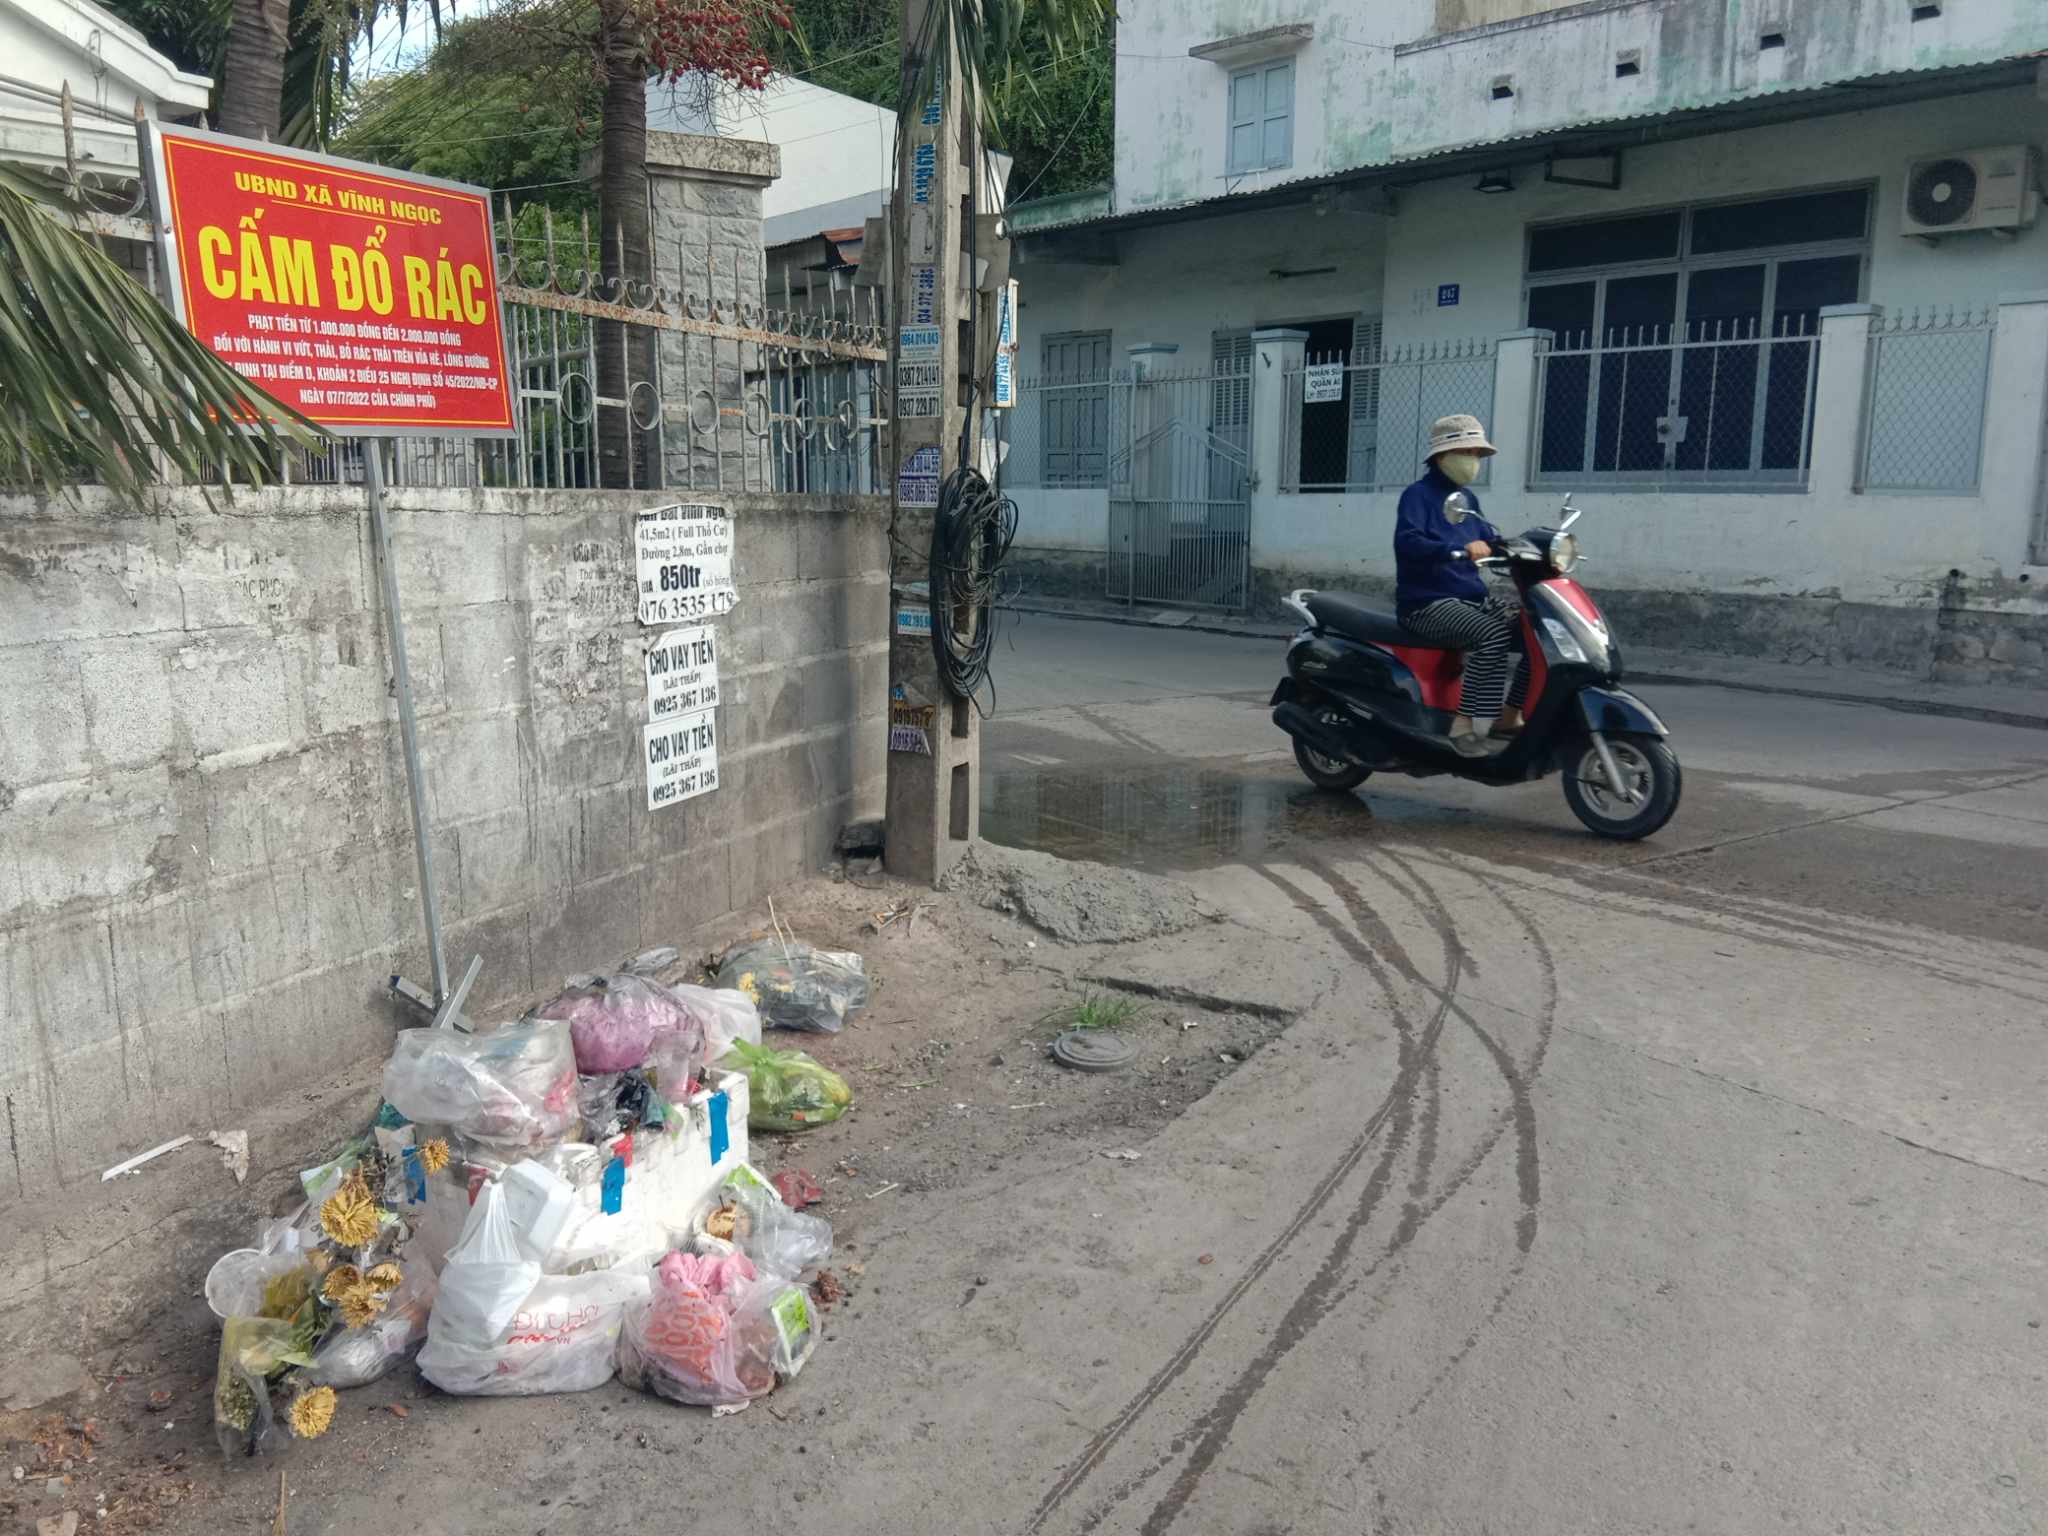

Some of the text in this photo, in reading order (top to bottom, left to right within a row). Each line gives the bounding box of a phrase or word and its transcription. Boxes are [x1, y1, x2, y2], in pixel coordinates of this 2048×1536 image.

[234, 172, 441, 227] UBND XÃ VĨNH NGỌC
[198, 207, 486, 325] CẤM ĐỔ RÁC
[248, 314, 273, 333] PHẠT
[298, 316, 311, 334] TỪ
[312, 321, 356, 337] 1.000.000
[382, 323, 399, 341] ĐẾN
[400, 329, 438, 345] 2.000.000
[213, 331, 231, 351] ĐỐI
[234, 335, 251, 353] VỚI
[253, 336, 280, 354] HÀNH
[282, 341, 292, 355] VI
[339, 342, 352, 360] BỎ
[353, 344, 370, 361] RÁC
[372, 345, 391, 362] THẢI
[393, 348, 415, 364] TRÊN
[443, 351, 464, 367] LÒNG
[464, 353, 490, 369] ĐƯỜNG
[261, 364, 277, 381] TẠI
[280, 360, 304, 380] ĐIỂM
[317, 364, 347, 382] KHOẢN
[349, 369, 356, 382] 2
[378, 370, 389, 384] 25
[391, 371, 411, 388] NGHỊ
[412, 372, 432, 388] ĐỊNH
[433, 370, 443, 387] SỐ
[300, 387, 325, 404] NGÀY
[371, 389, 389, 406] CỦA
[390, 391, 415, 408] CHÍNH
[642, 546, 671, 561] Đường
[660, 564, 701, 591] 850tr
[641, 599, 667, 621] 076
[671, 595, 705, 619] 3535
[650, 647, 669, 676] CHO
[670, 643, 689, 671] VAY
[654, 686, 717, 715] 0925 367 136
[650, 735, 669, 764] CHO
[671, 730, 689, 757] VAY
[653, 769, 716, 802] 0925 367 136
